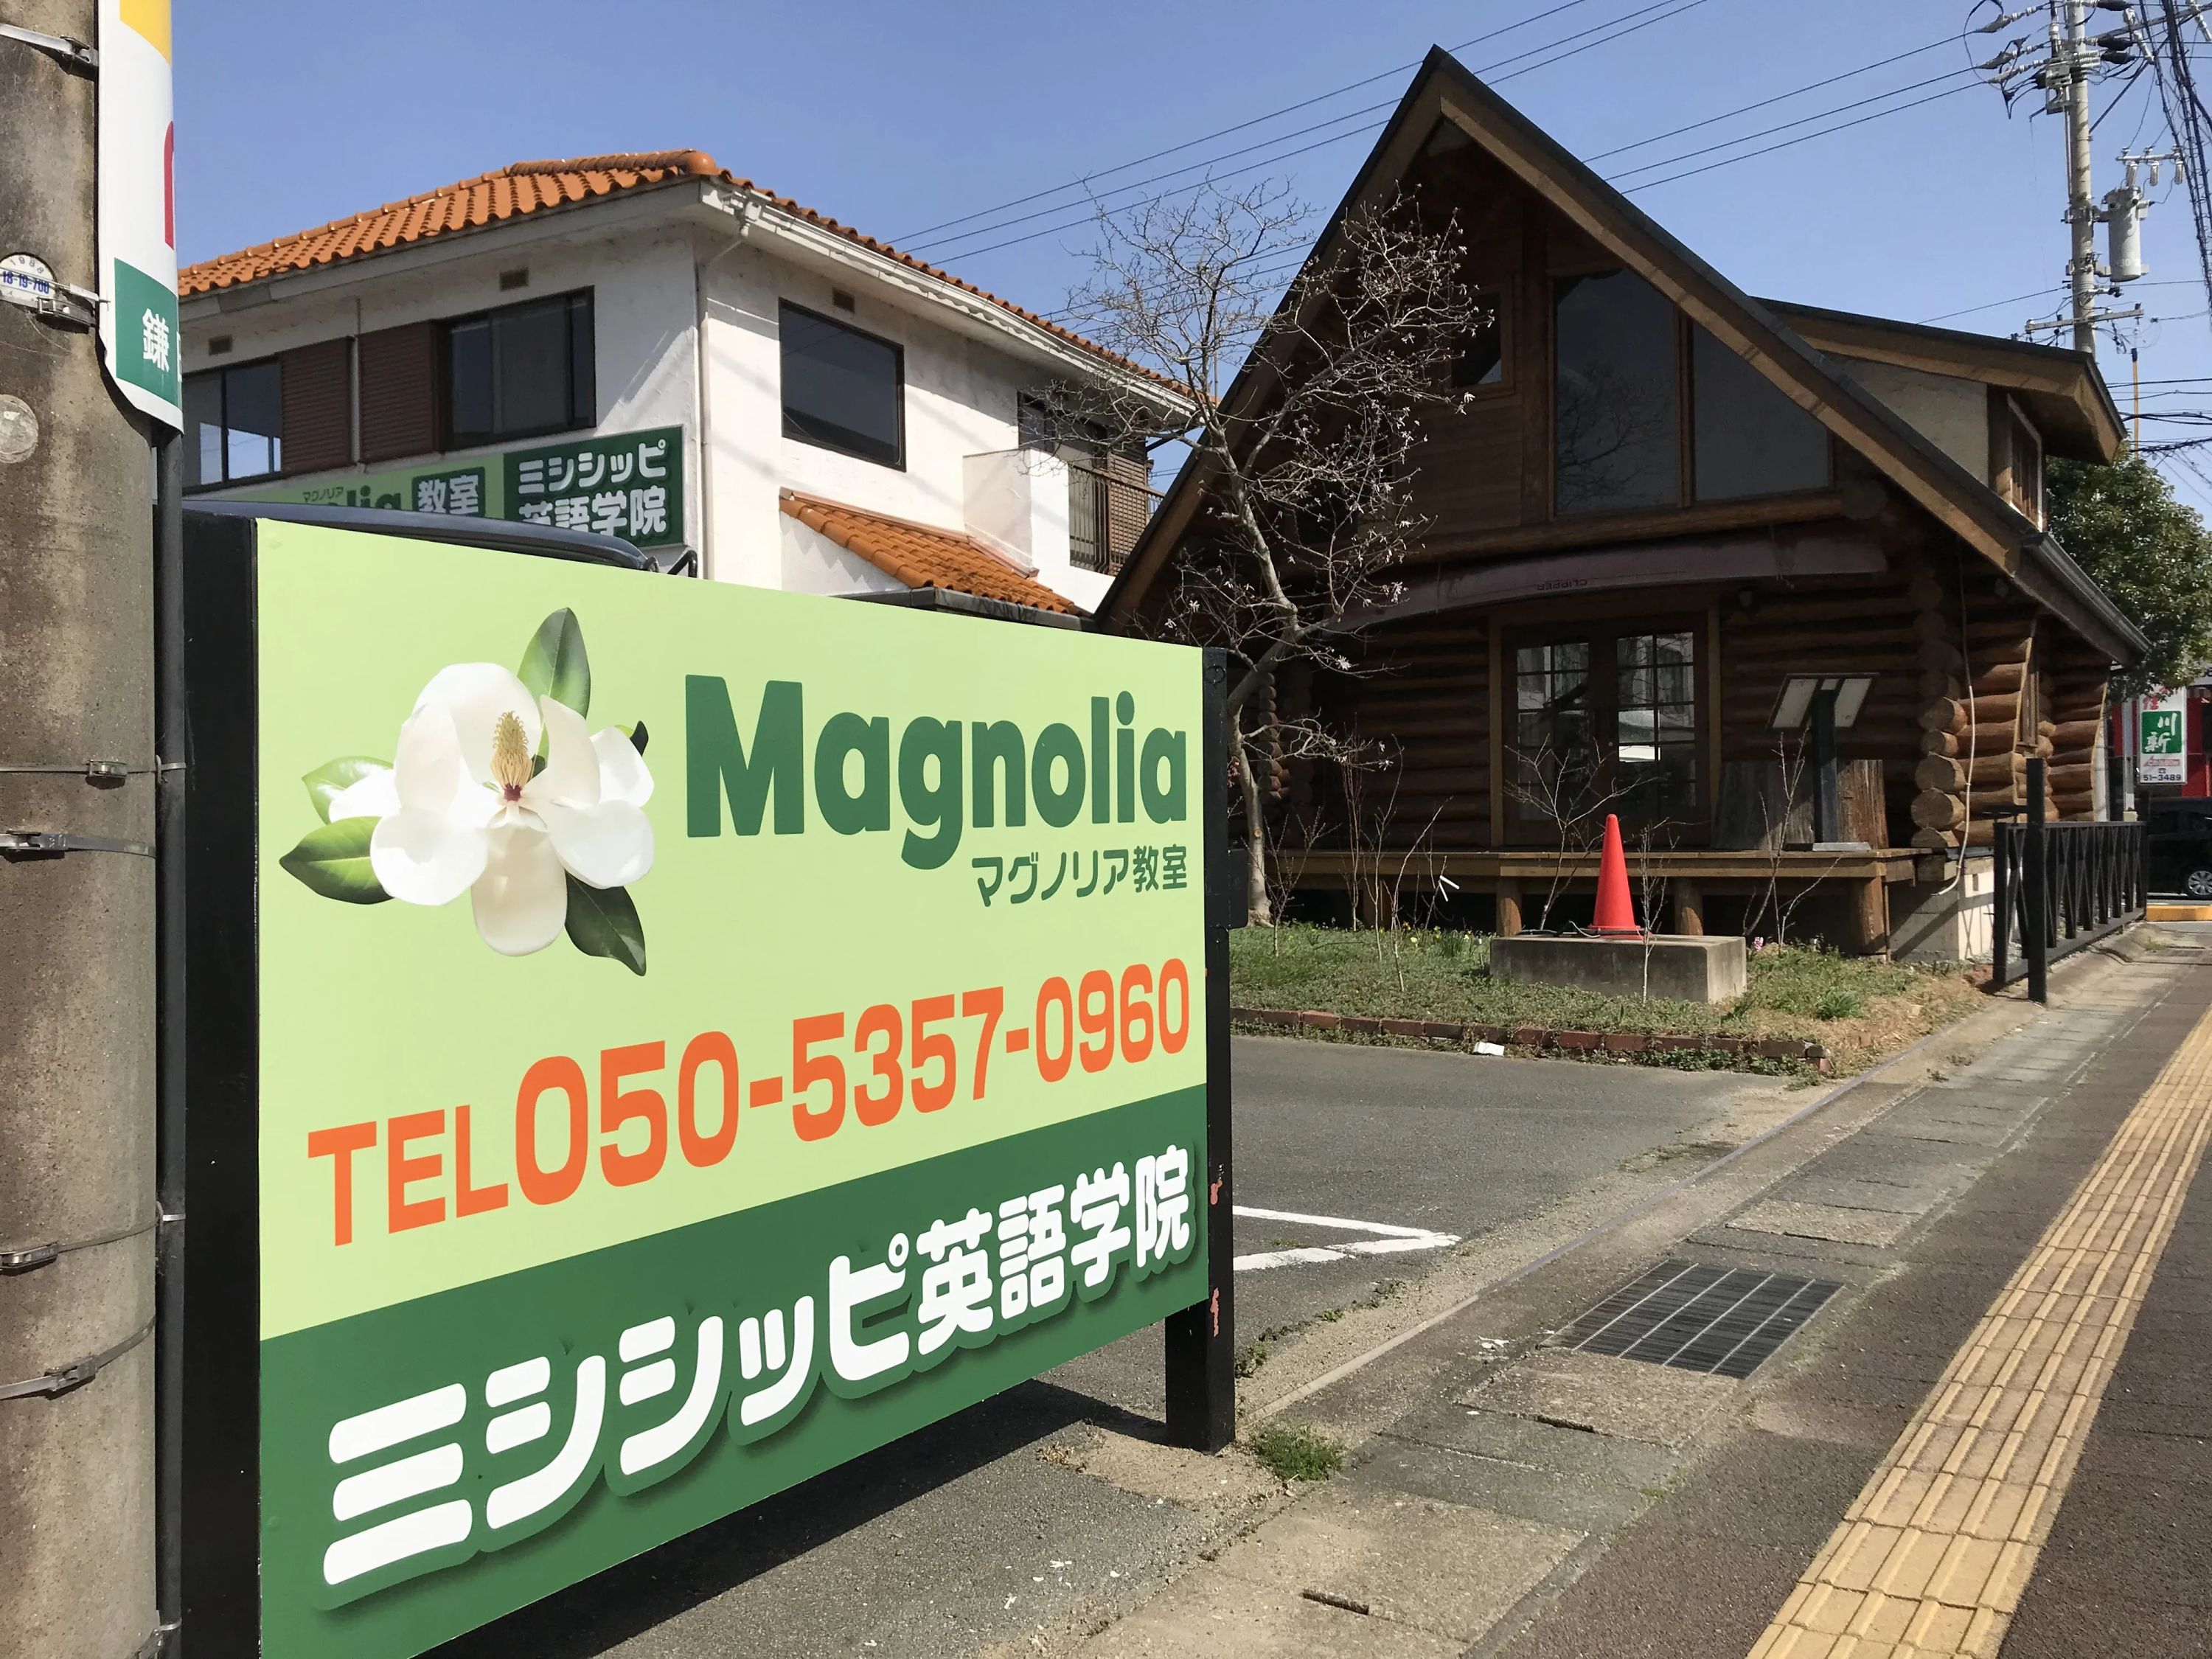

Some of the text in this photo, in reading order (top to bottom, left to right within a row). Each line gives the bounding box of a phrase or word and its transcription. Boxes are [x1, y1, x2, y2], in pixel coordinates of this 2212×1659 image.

[10, 256, 44, 274] 1988
[518, 439, 666, 494] ミシシッピ
[417, 475, 479, 514] 教室
[1537, 579, 1588, 591] CLIPPER
[686, 674, 1186, 870] Magnolia
[2143, 773, 2182, 782] 51-3489
[972, 844, 1187, 907] マグノリア教室
[324, 1144, 1192, 1586] ミシシッピ英語学院
